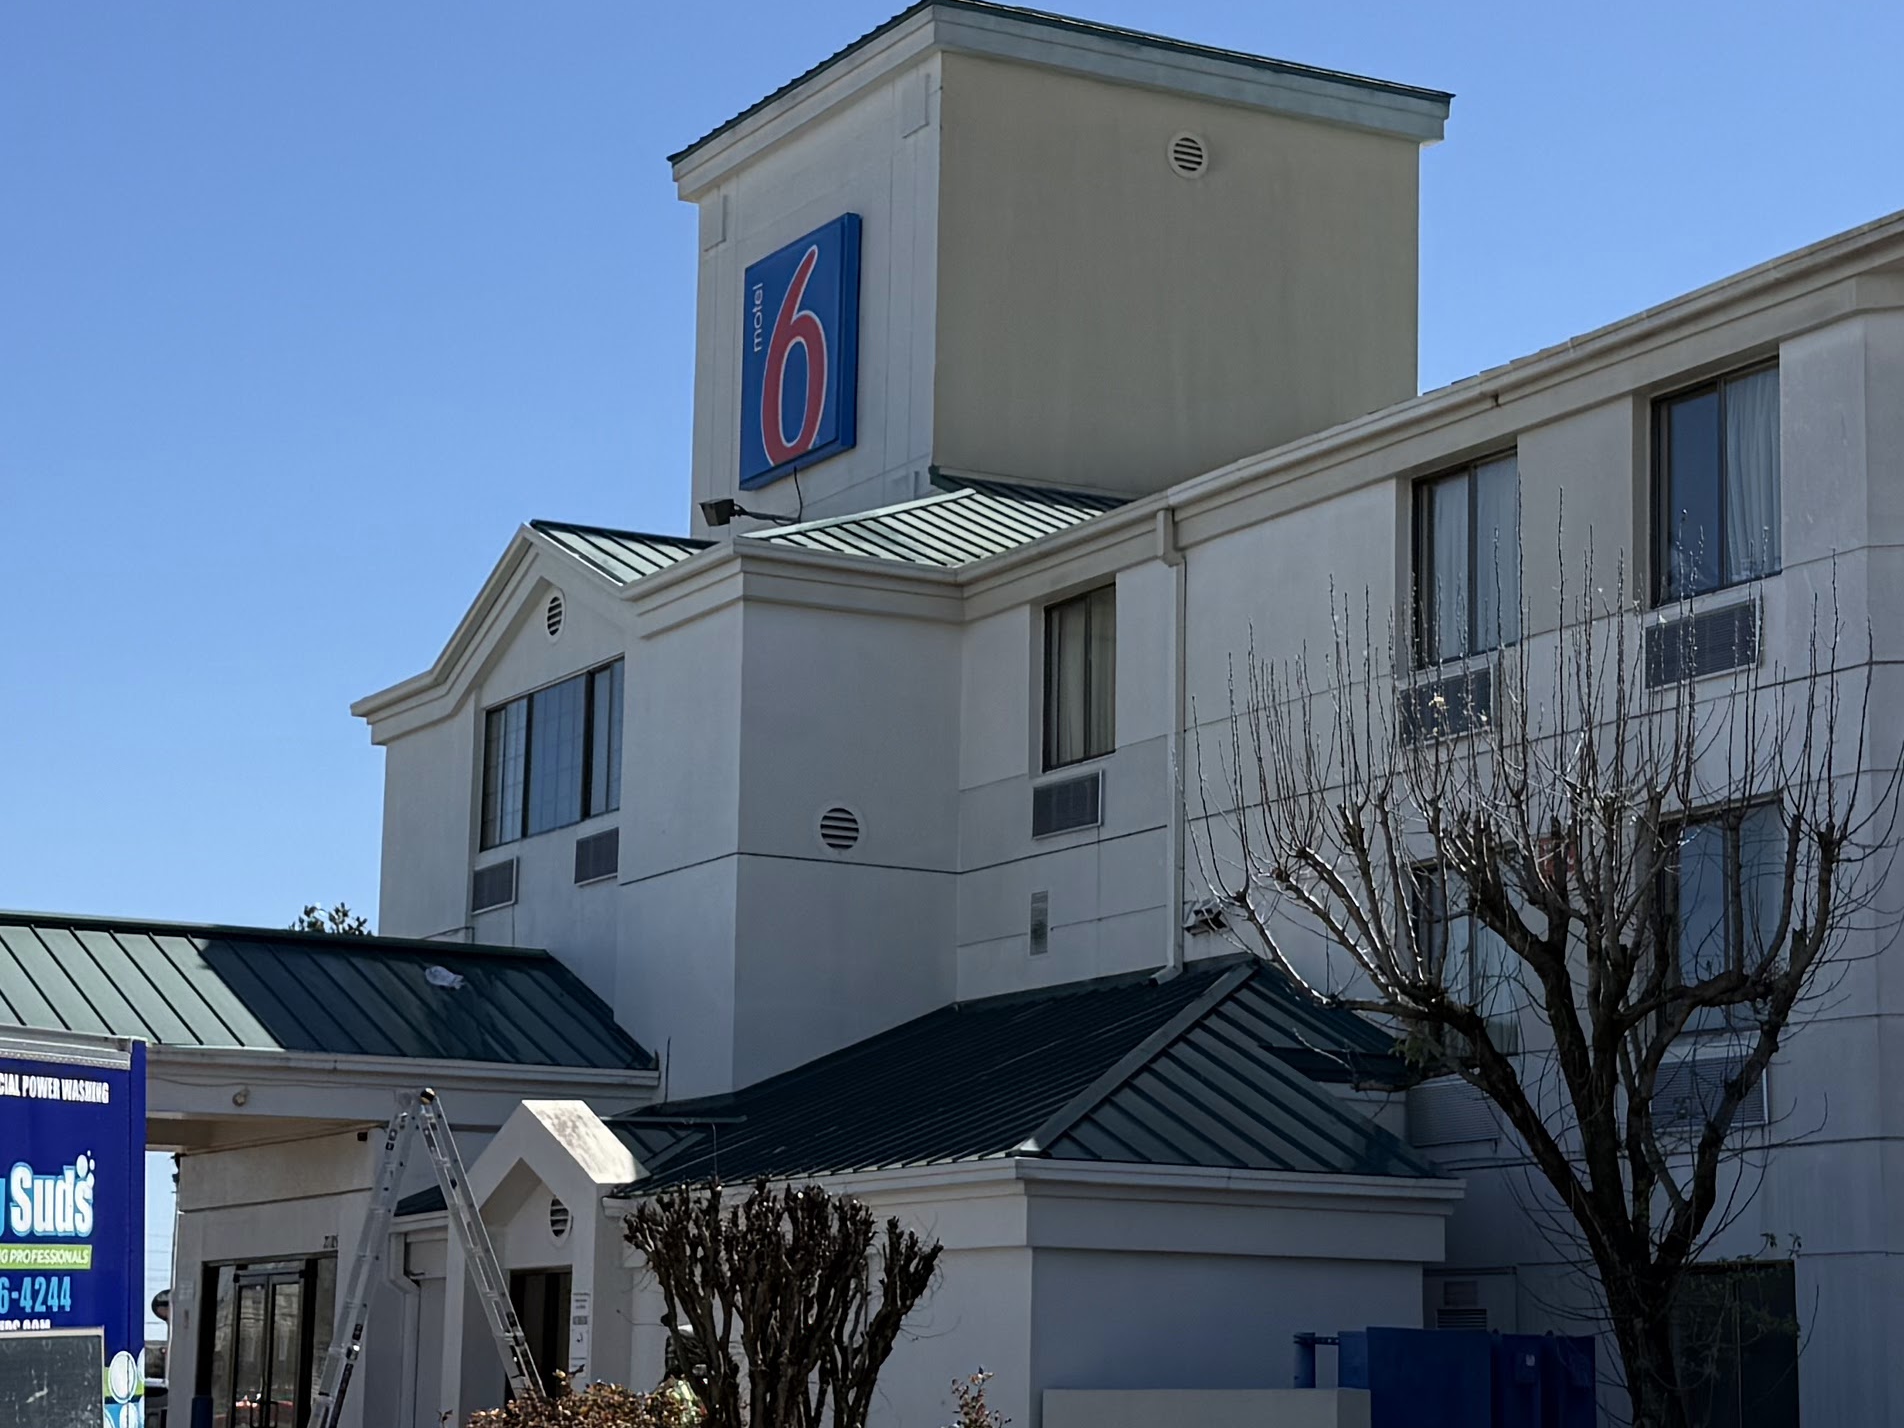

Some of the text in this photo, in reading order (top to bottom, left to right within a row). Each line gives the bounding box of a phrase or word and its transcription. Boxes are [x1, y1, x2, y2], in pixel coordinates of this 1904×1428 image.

[752, 282, 764, 353] motel
[762, 244, 827, 467] 6
[22, 1075, 60, 1100] POWER
[61, 1078, 110, 1104] WASHING
[9, 1161, 94, 1237] Suds
[9, 1249, 90, 1264] PROFESSIONALS
